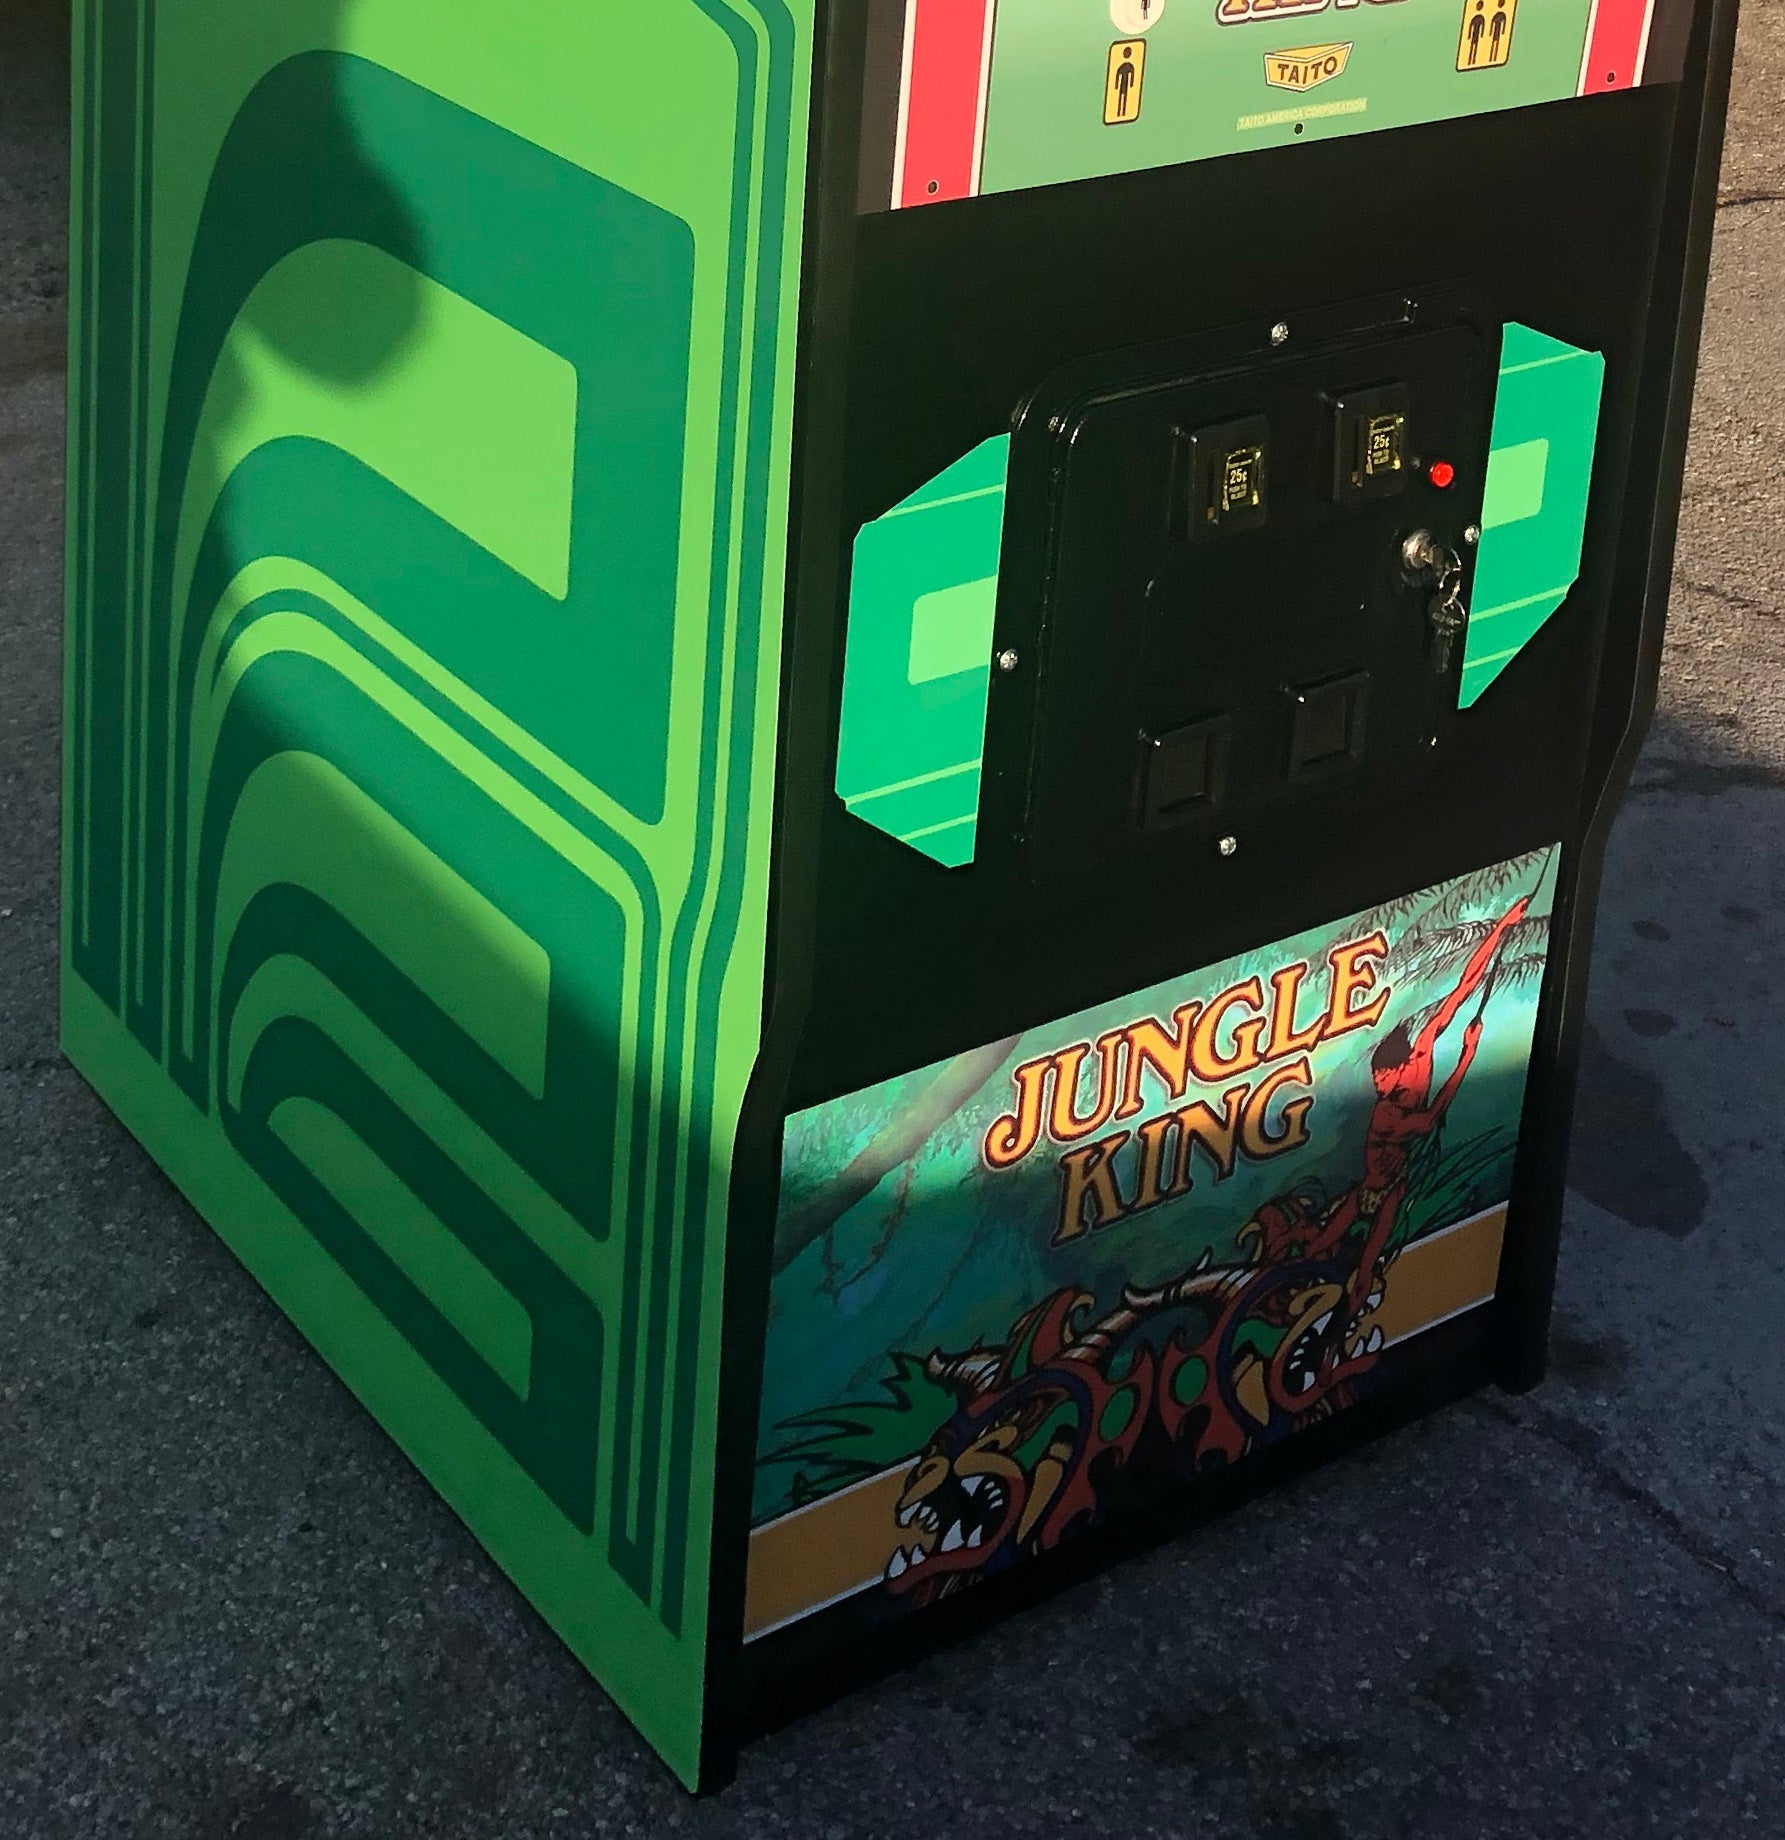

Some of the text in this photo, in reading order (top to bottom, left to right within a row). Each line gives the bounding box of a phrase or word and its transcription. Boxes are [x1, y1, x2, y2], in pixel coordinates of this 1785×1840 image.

[1277, 55, 1338, 85] TAITO
[983, 930, 1393, 1171] JUNGLE
[1050, 1064, 1317, 1248] KING
